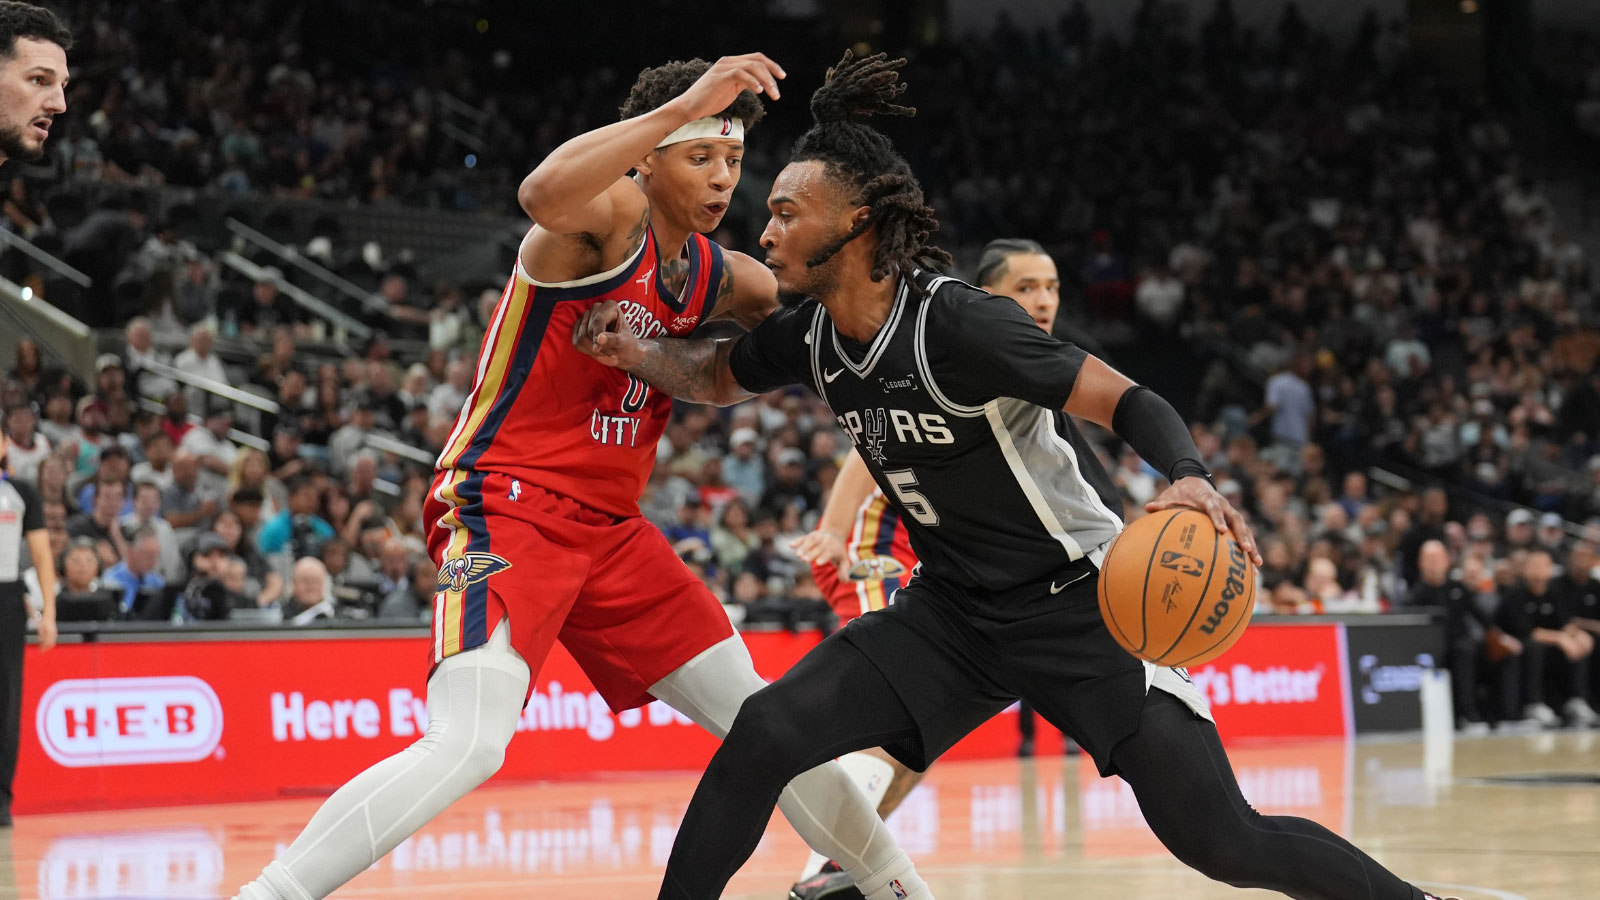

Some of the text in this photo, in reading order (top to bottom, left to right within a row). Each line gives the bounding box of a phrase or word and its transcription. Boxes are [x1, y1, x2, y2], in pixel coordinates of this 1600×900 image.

[885, 379, 912, 389] LEDGER
[590, 407, 641, 447] CITY
[883, 467, 940, 527] 5
[1199, 538, 1247, 635] Wilson
[1231, 663, 1319, 704] Better
[270, 691, 381, 741] Here
